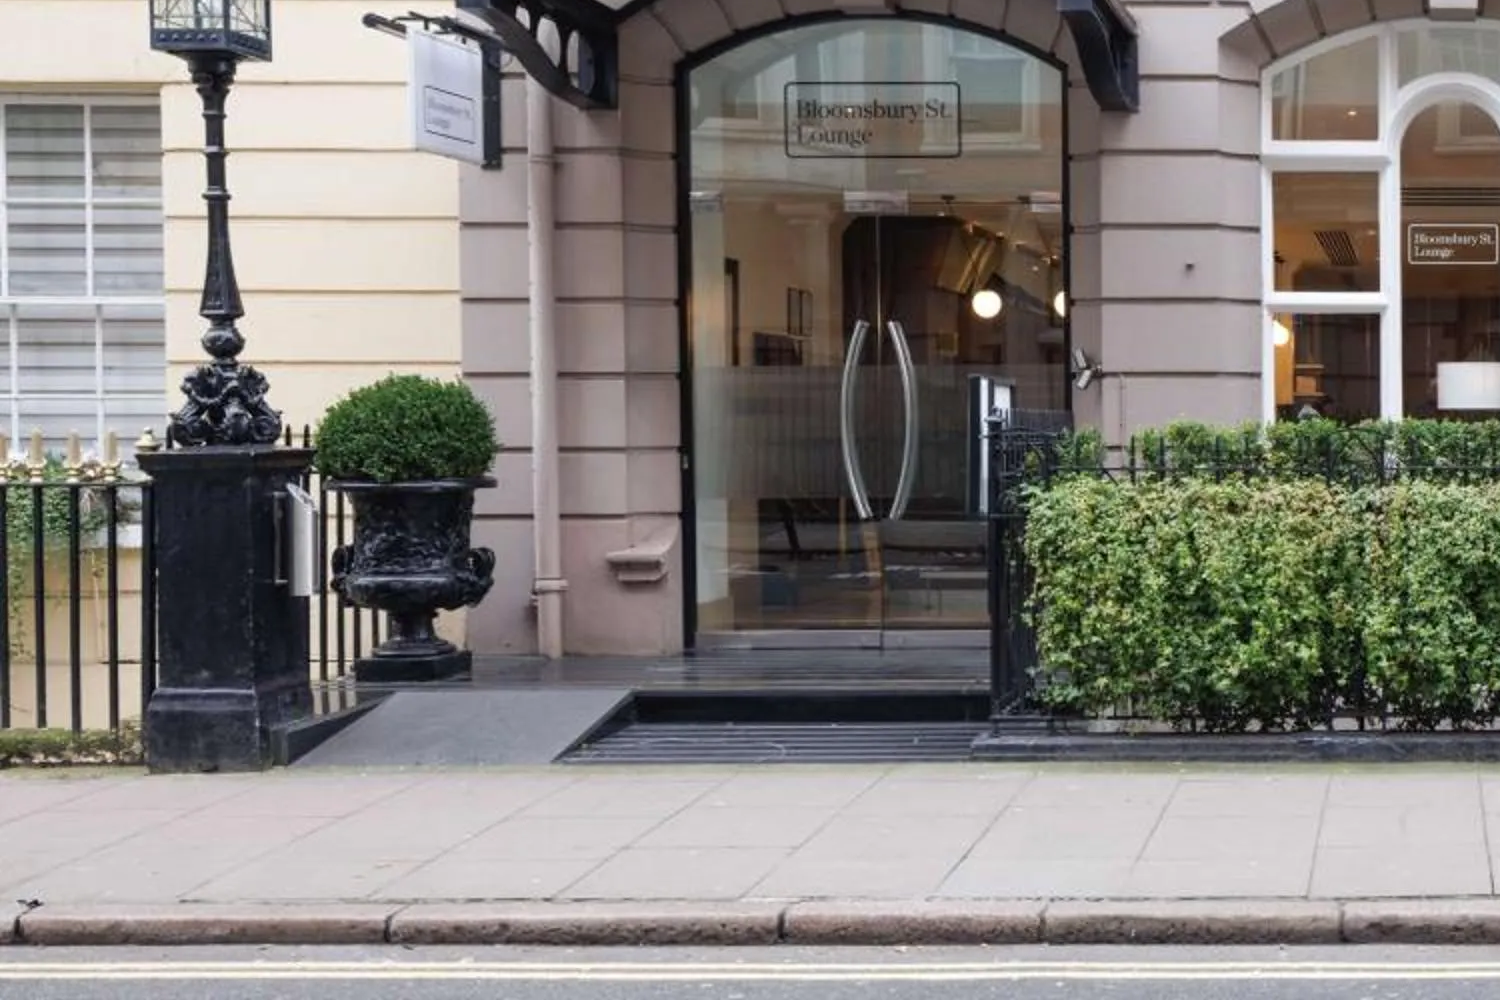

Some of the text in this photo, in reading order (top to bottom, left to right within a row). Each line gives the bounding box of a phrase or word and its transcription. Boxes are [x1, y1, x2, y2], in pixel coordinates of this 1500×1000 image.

[797, 98, 952, 123] Bloomsbury St.
[797, 124, 873, 148] Lounge
